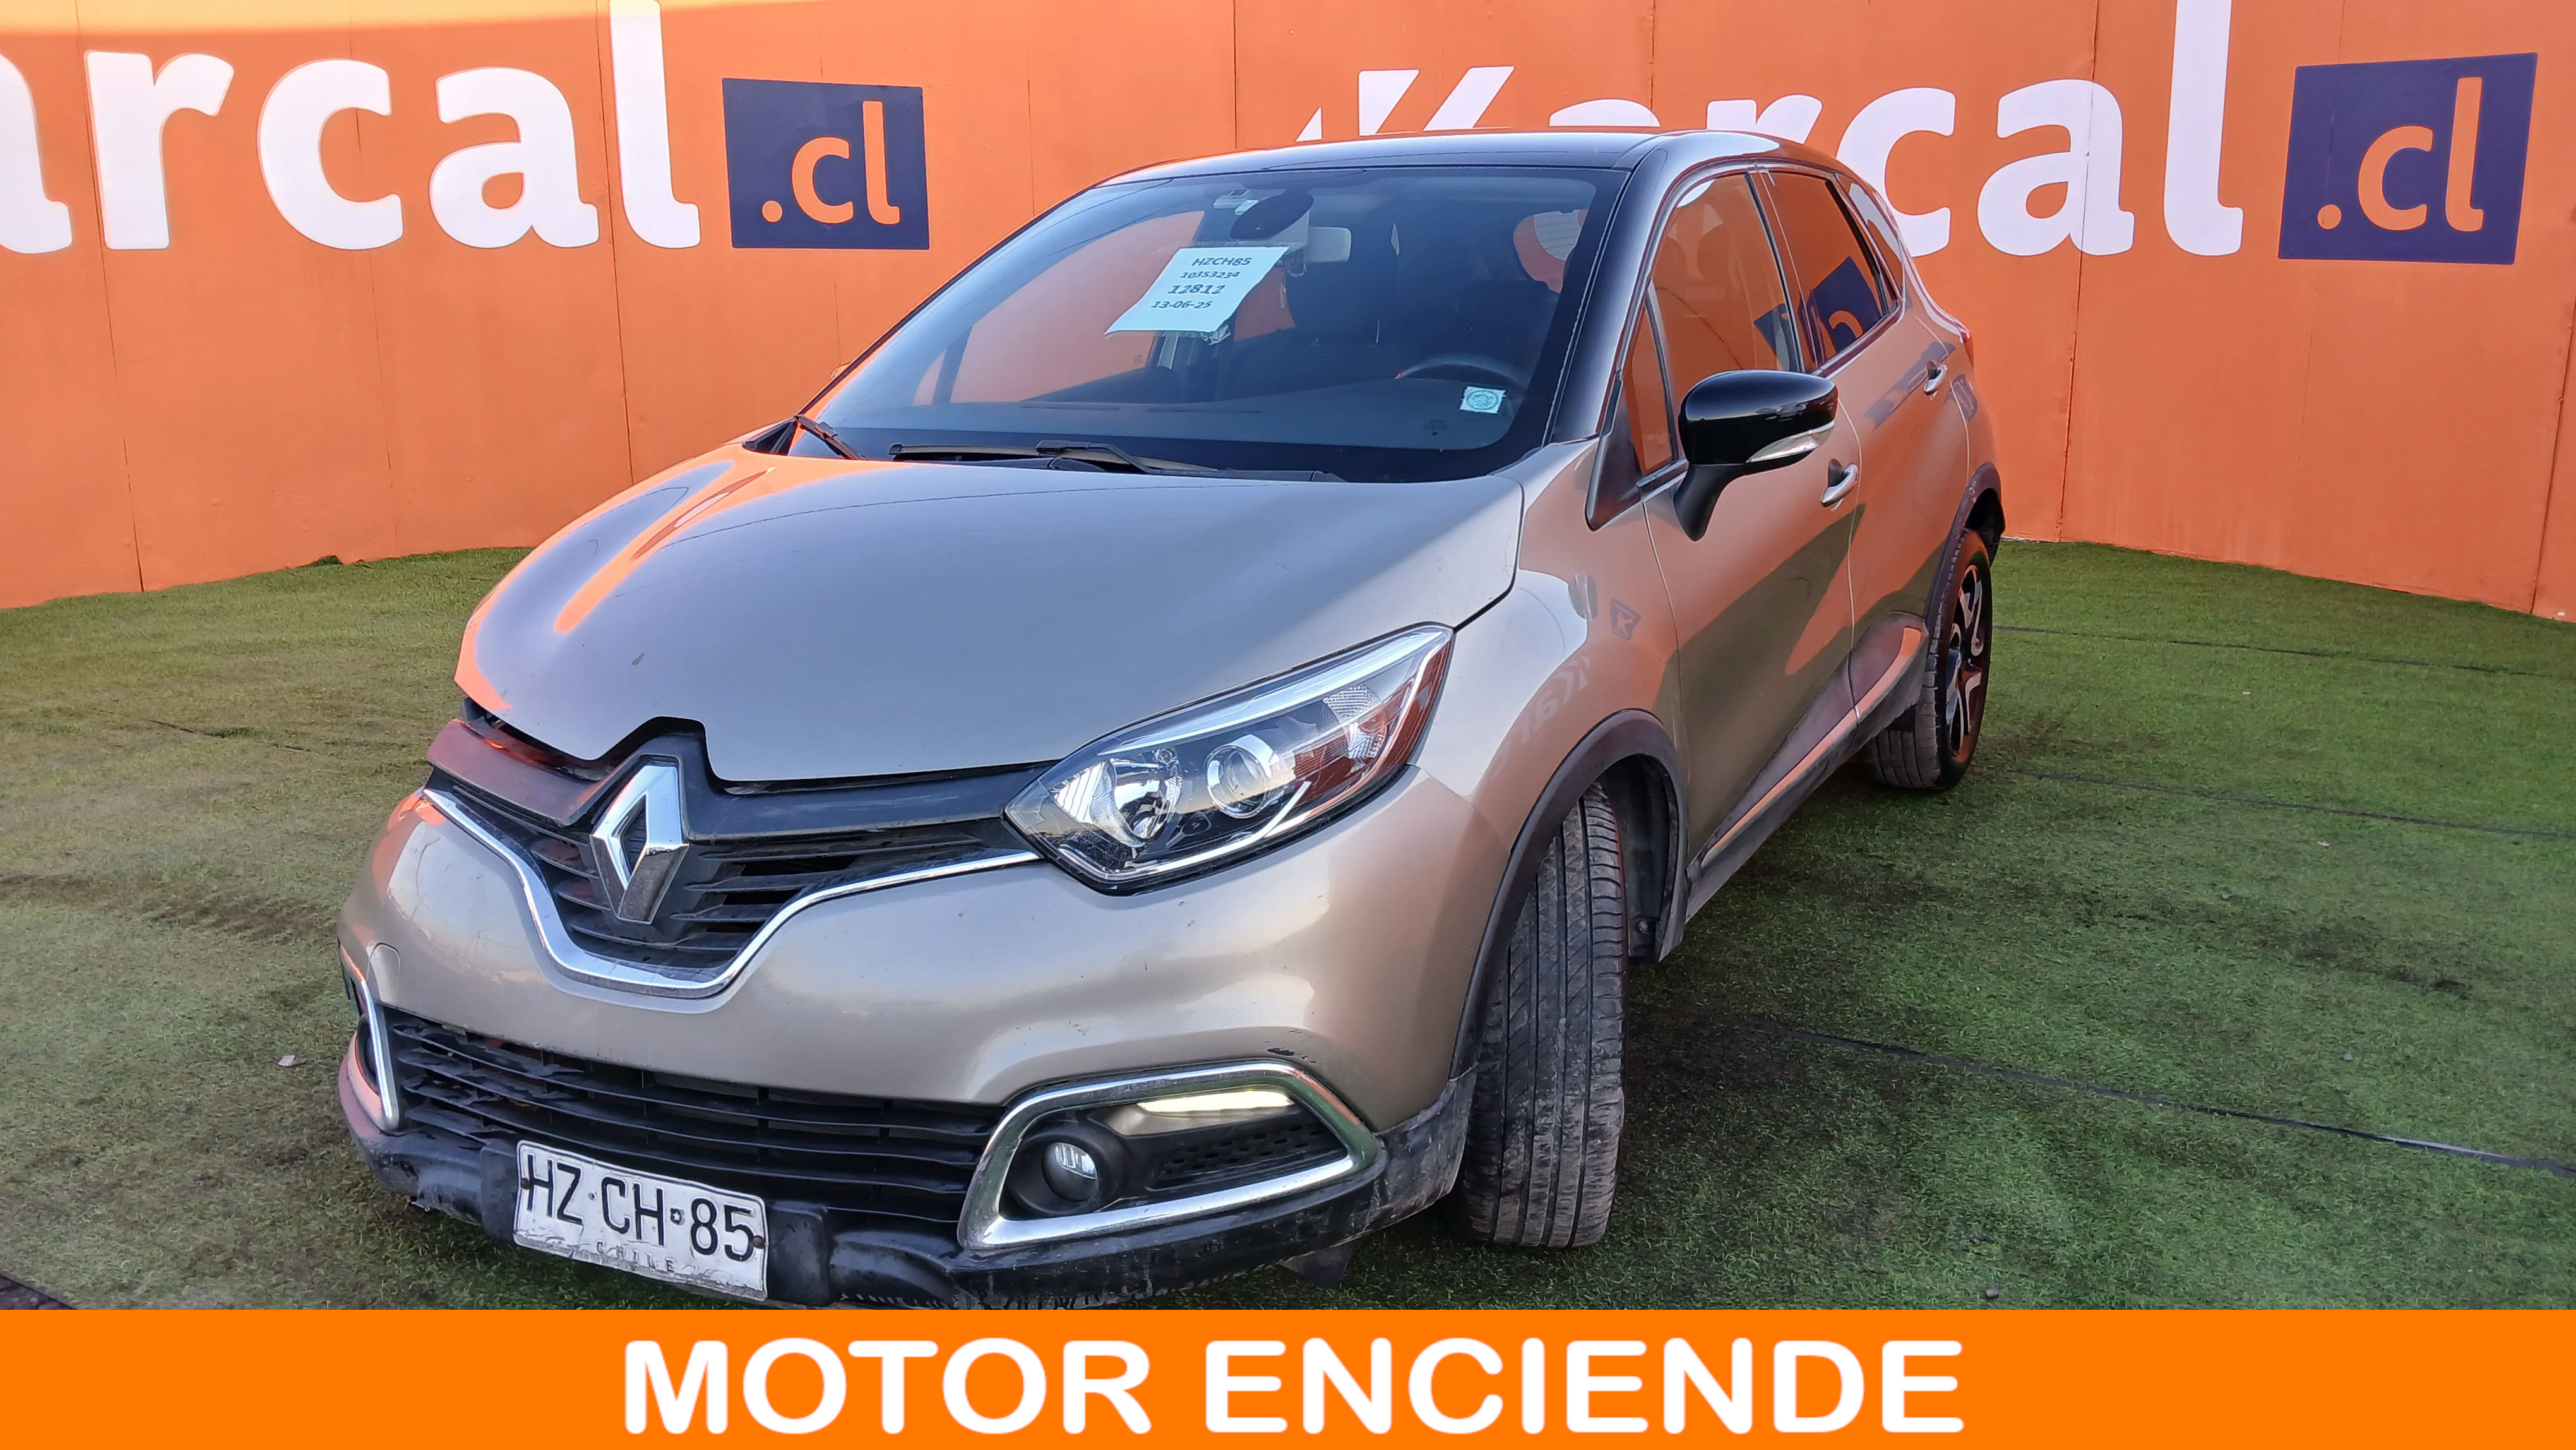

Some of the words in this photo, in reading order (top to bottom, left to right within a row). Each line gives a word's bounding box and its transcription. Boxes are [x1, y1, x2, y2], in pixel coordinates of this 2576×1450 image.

[2317, 76, 2484, 232] .cl
[761, 100, 901, 225] .cl
[1191, 257, 1253, 267] HZCH85
[1179, 271, 1241, 279] 10353234
[1167, 284, 1226, 295] 12812
[1150, 300, 1213, 309] 13-06-25
[596, 1240, 676, 1273] CHILE
